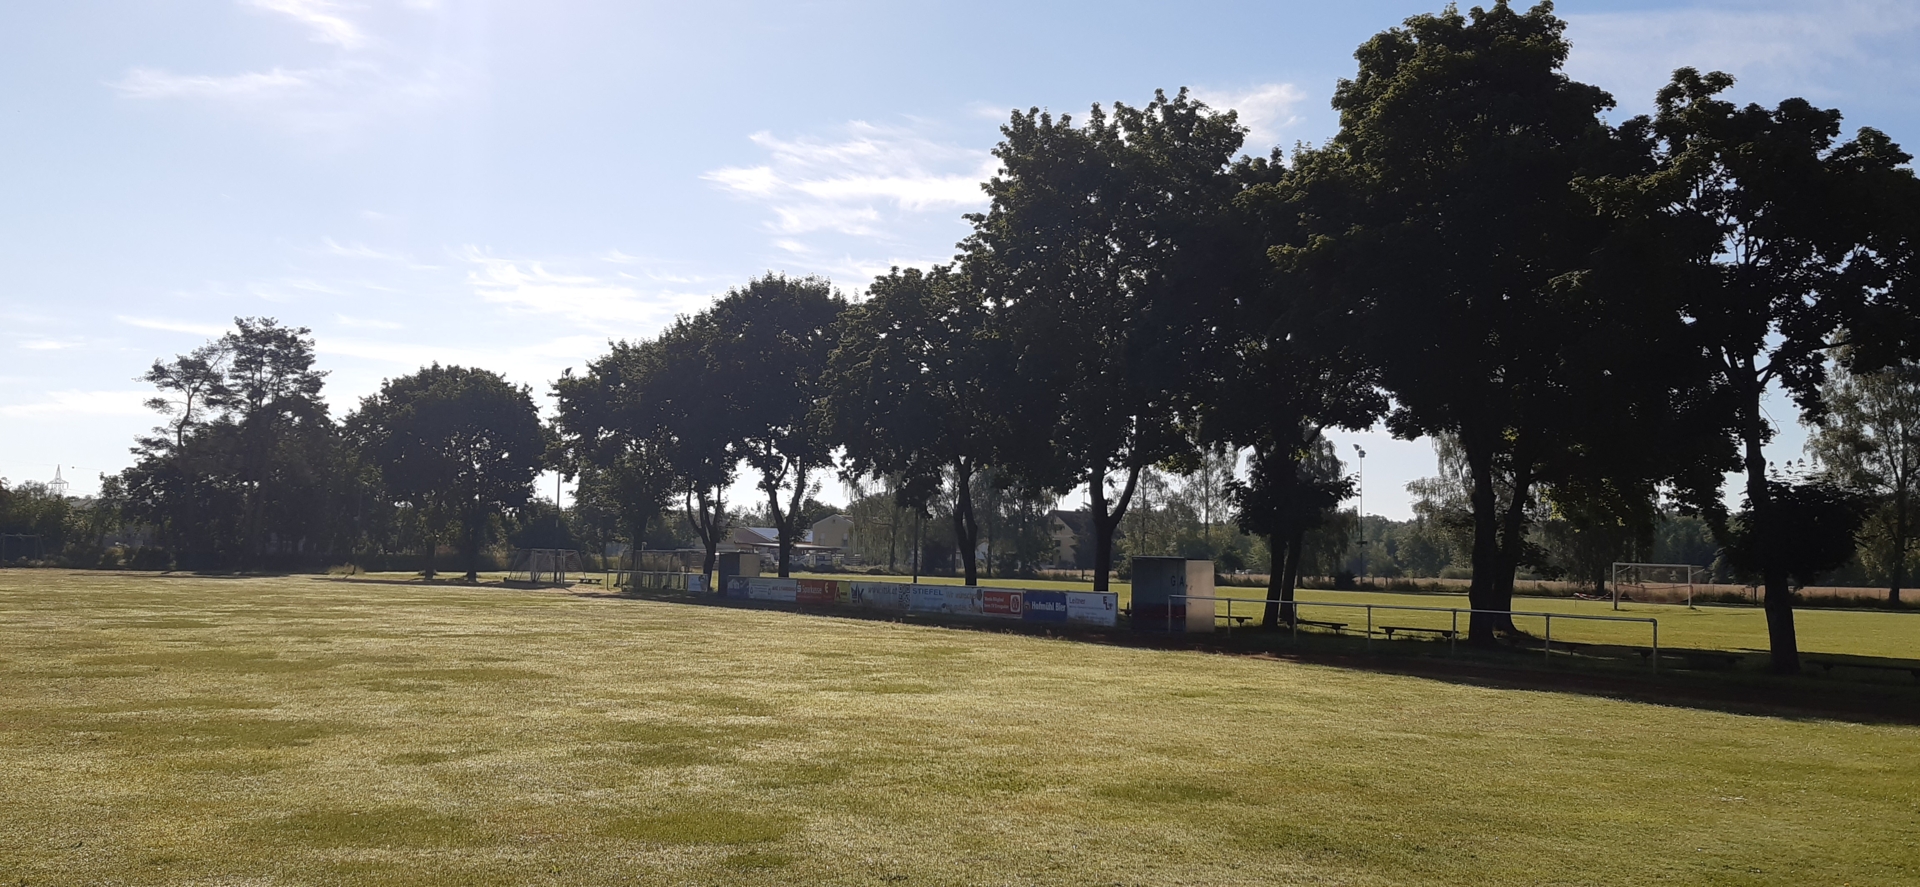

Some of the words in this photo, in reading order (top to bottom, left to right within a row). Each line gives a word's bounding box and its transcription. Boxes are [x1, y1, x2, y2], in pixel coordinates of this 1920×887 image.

[802, 585, 822, 595] Sparkasse
[1031, 601, 1054, 611] Hofmühl
[1055, 602, 1066, 612] Bier
